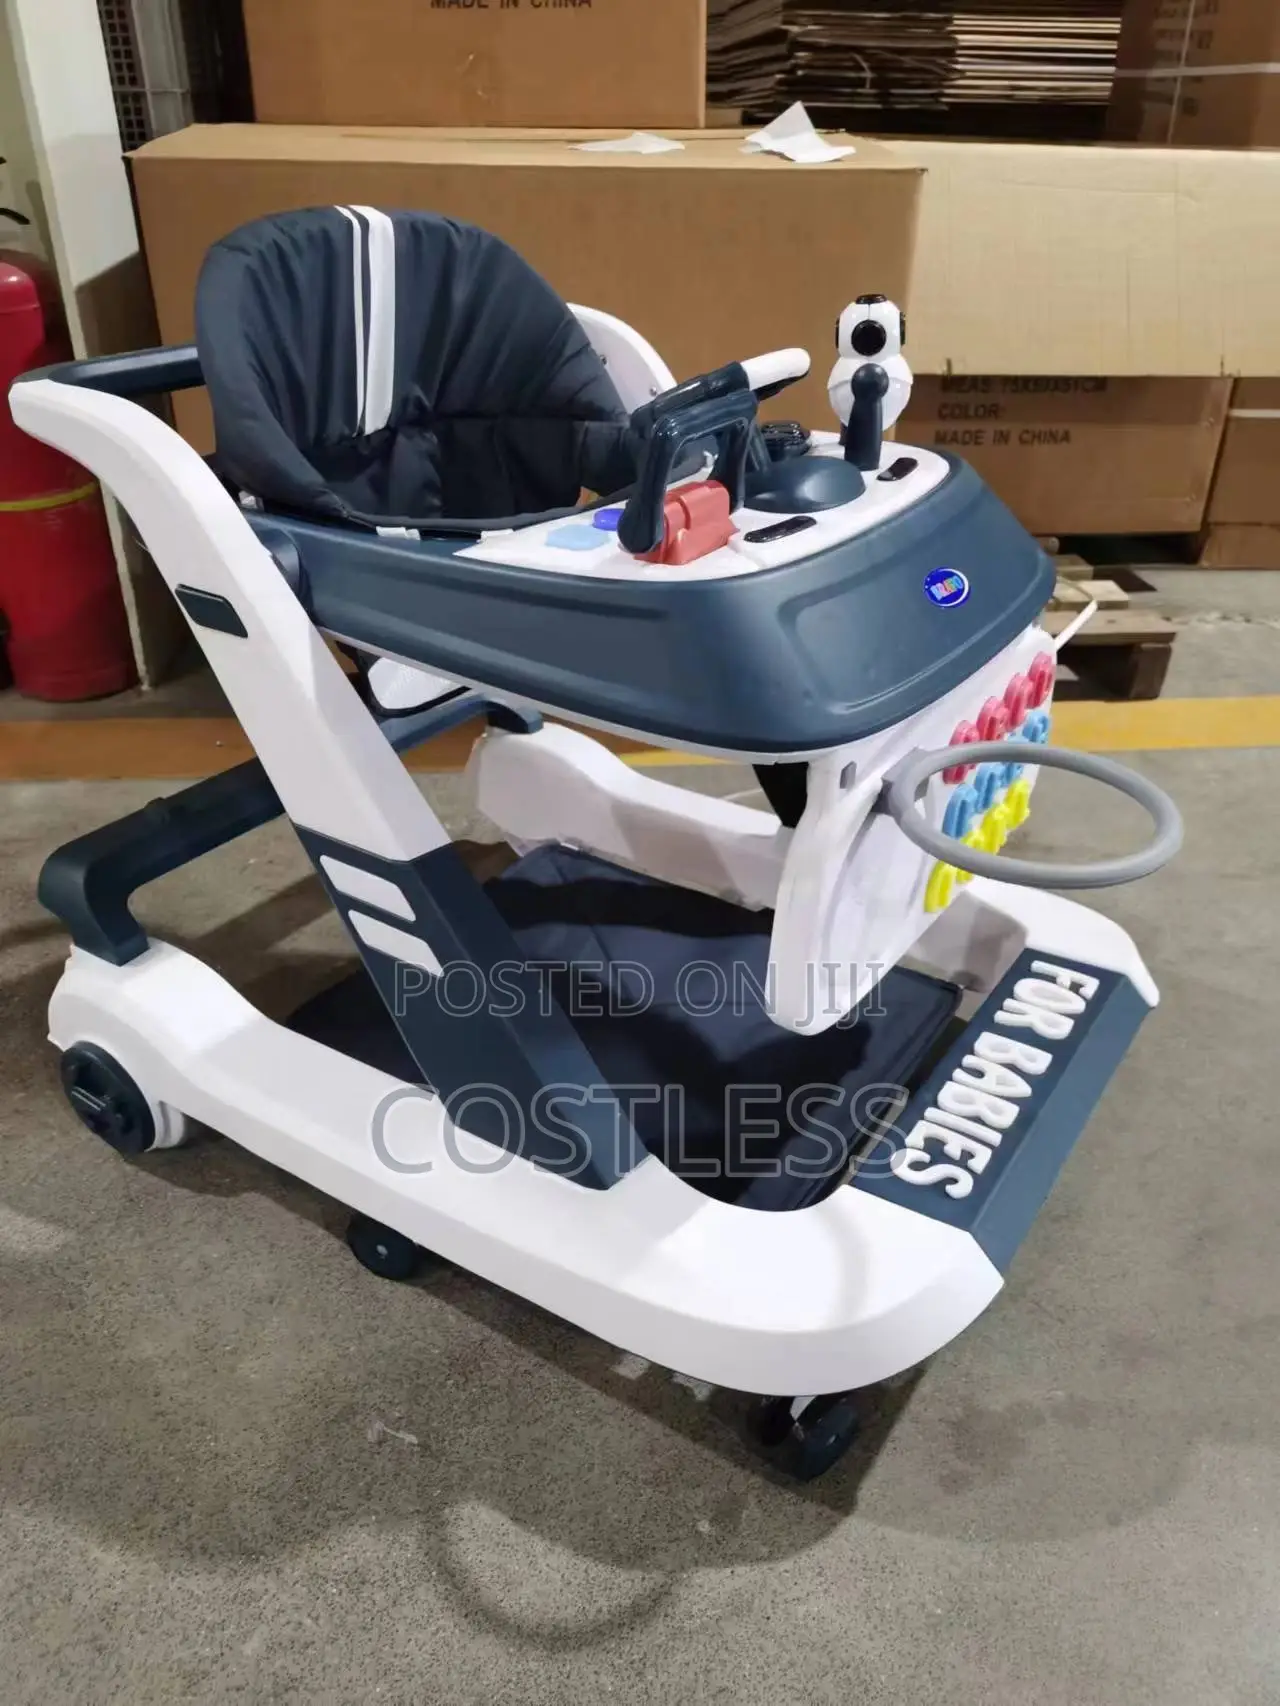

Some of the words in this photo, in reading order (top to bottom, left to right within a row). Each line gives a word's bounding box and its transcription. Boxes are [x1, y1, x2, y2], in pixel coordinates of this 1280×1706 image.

[430, 0, 489, 9] MADE
[499, 0, 519, 9] IN
[530, 0, 592, 9] CHINA
[934, 429, 986, 446] MADE
[993, 429, 1012, 445] IN
[1018, 428, 1071, 445] CHINA
[994, 960, 1100, 1040] FOR
[890, 1031, 1053, 1199] BABIES
